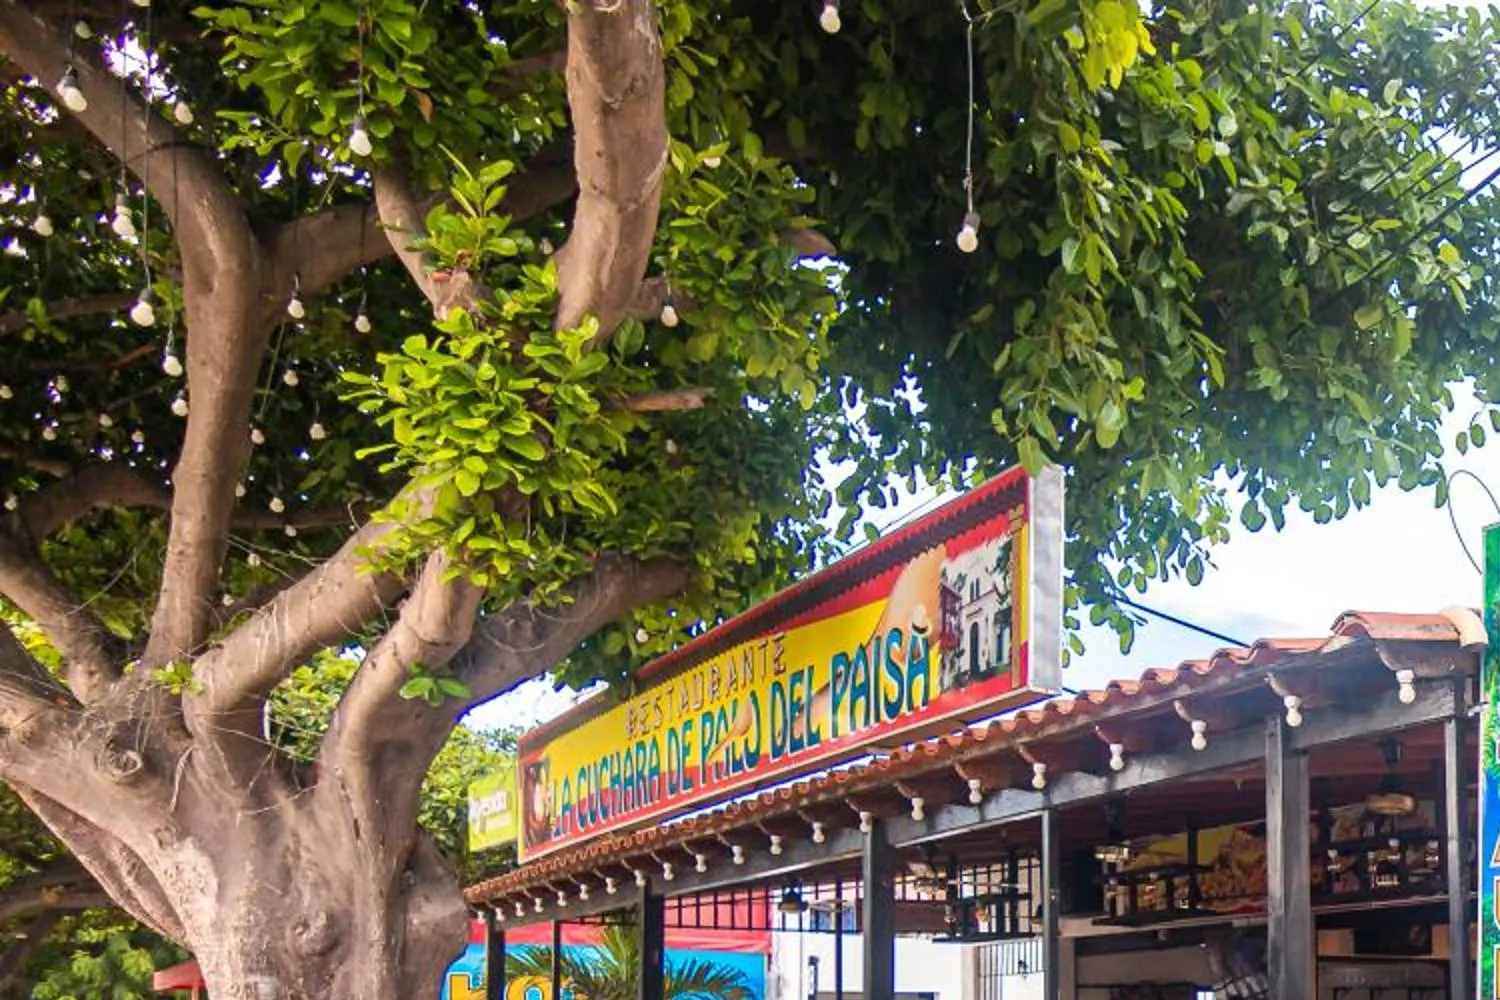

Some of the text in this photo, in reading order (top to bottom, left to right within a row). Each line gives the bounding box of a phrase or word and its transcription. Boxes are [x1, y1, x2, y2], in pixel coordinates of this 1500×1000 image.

[551, 775, 573, 842] LA
[576, 735, 661, 832] CUCHARA
[666, 717, 695, 799] DE
[768, 665, 821, 762] DEL
[625, 632, 787, 739] RESTAURANTE
